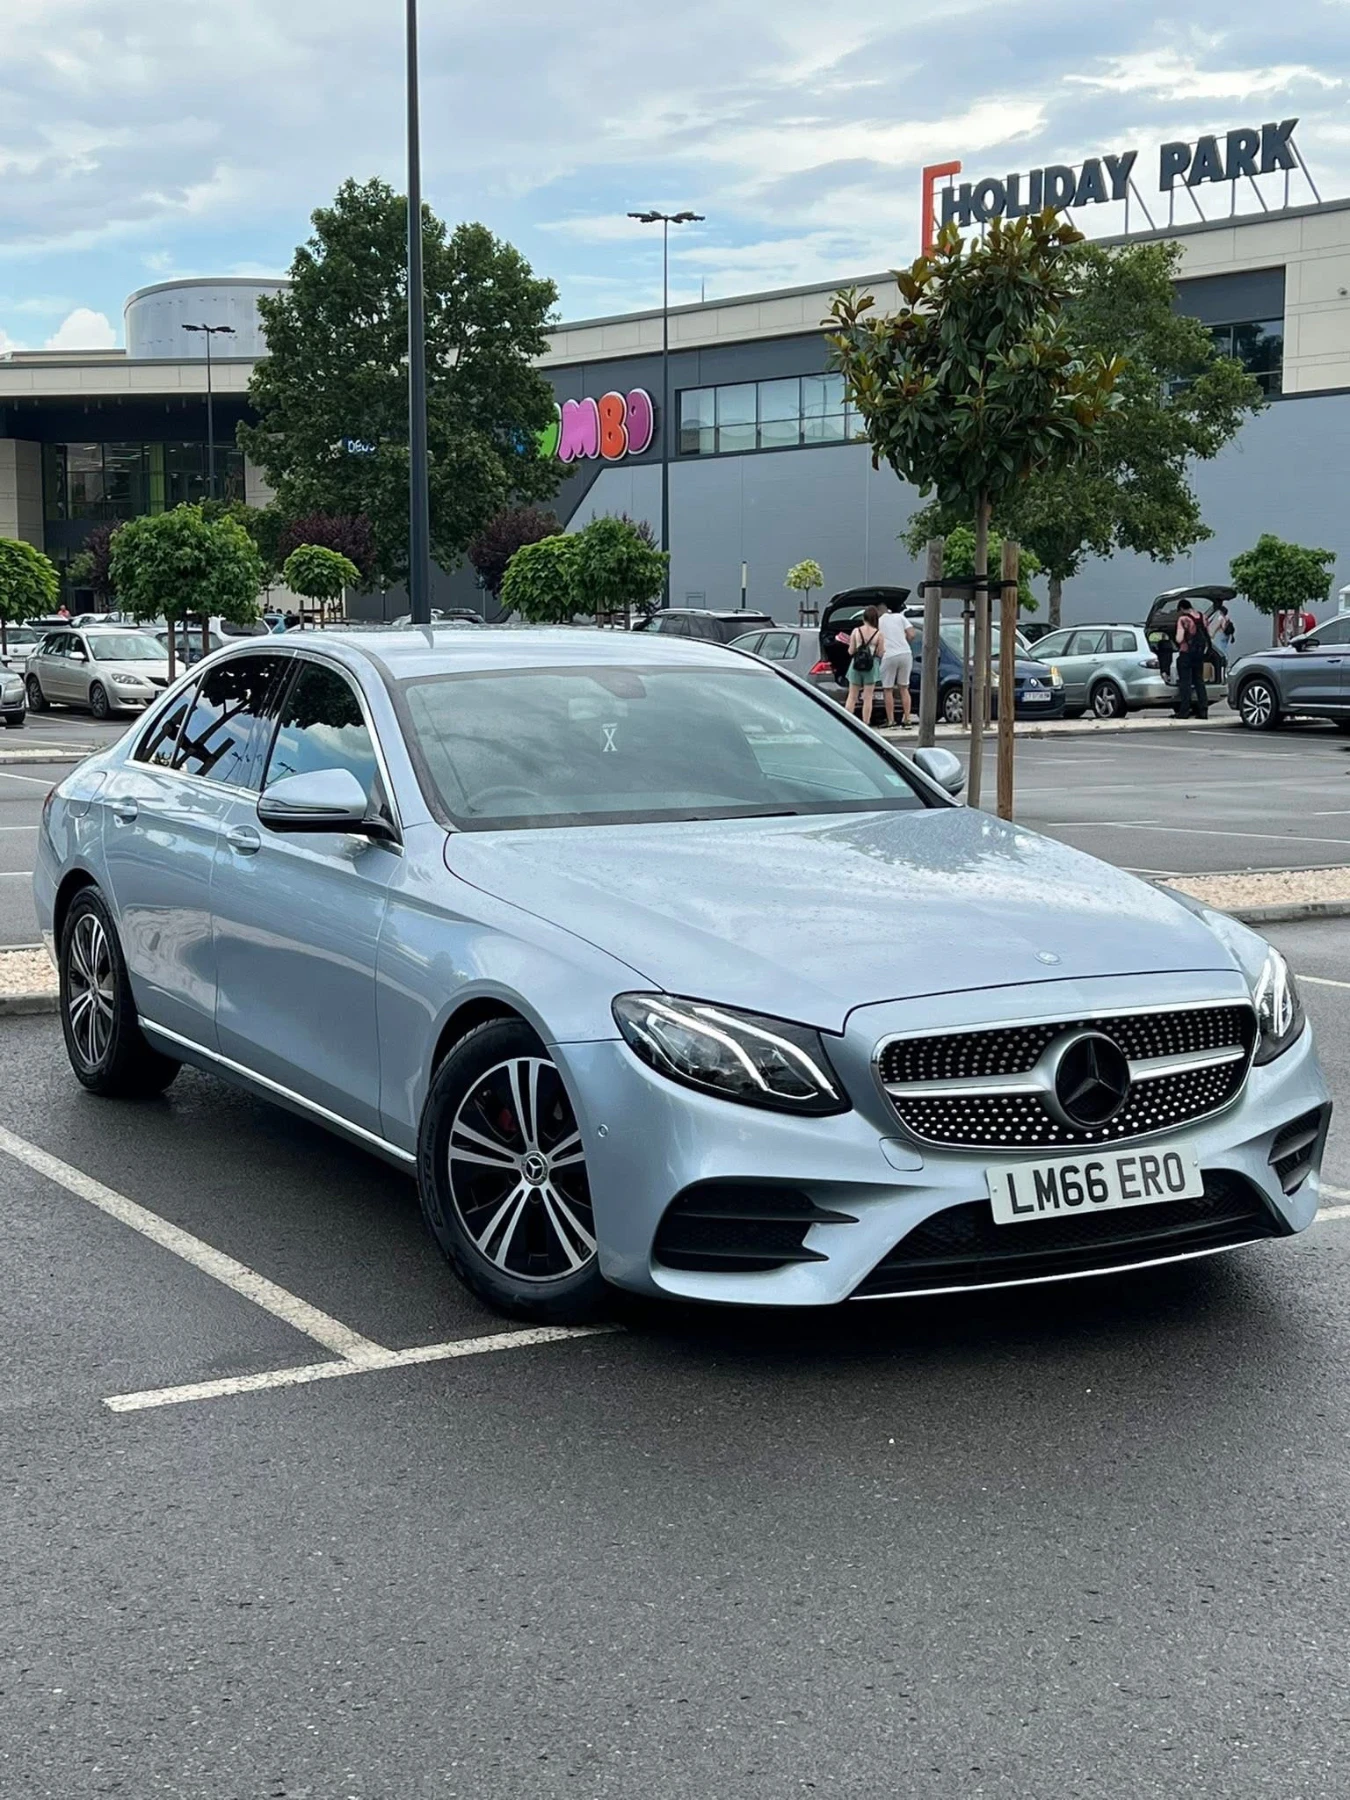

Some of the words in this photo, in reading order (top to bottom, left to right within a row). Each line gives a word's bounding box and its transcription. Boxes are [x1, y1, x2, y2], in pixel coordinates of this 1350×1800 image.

[941, 149, 1139, 229] HOLIDAY
[1159, 117, 1300, 192] PARK
[1006, 1161, 1109, 1215] LM66
[1116, 1151, 1186, 1200] ERO
